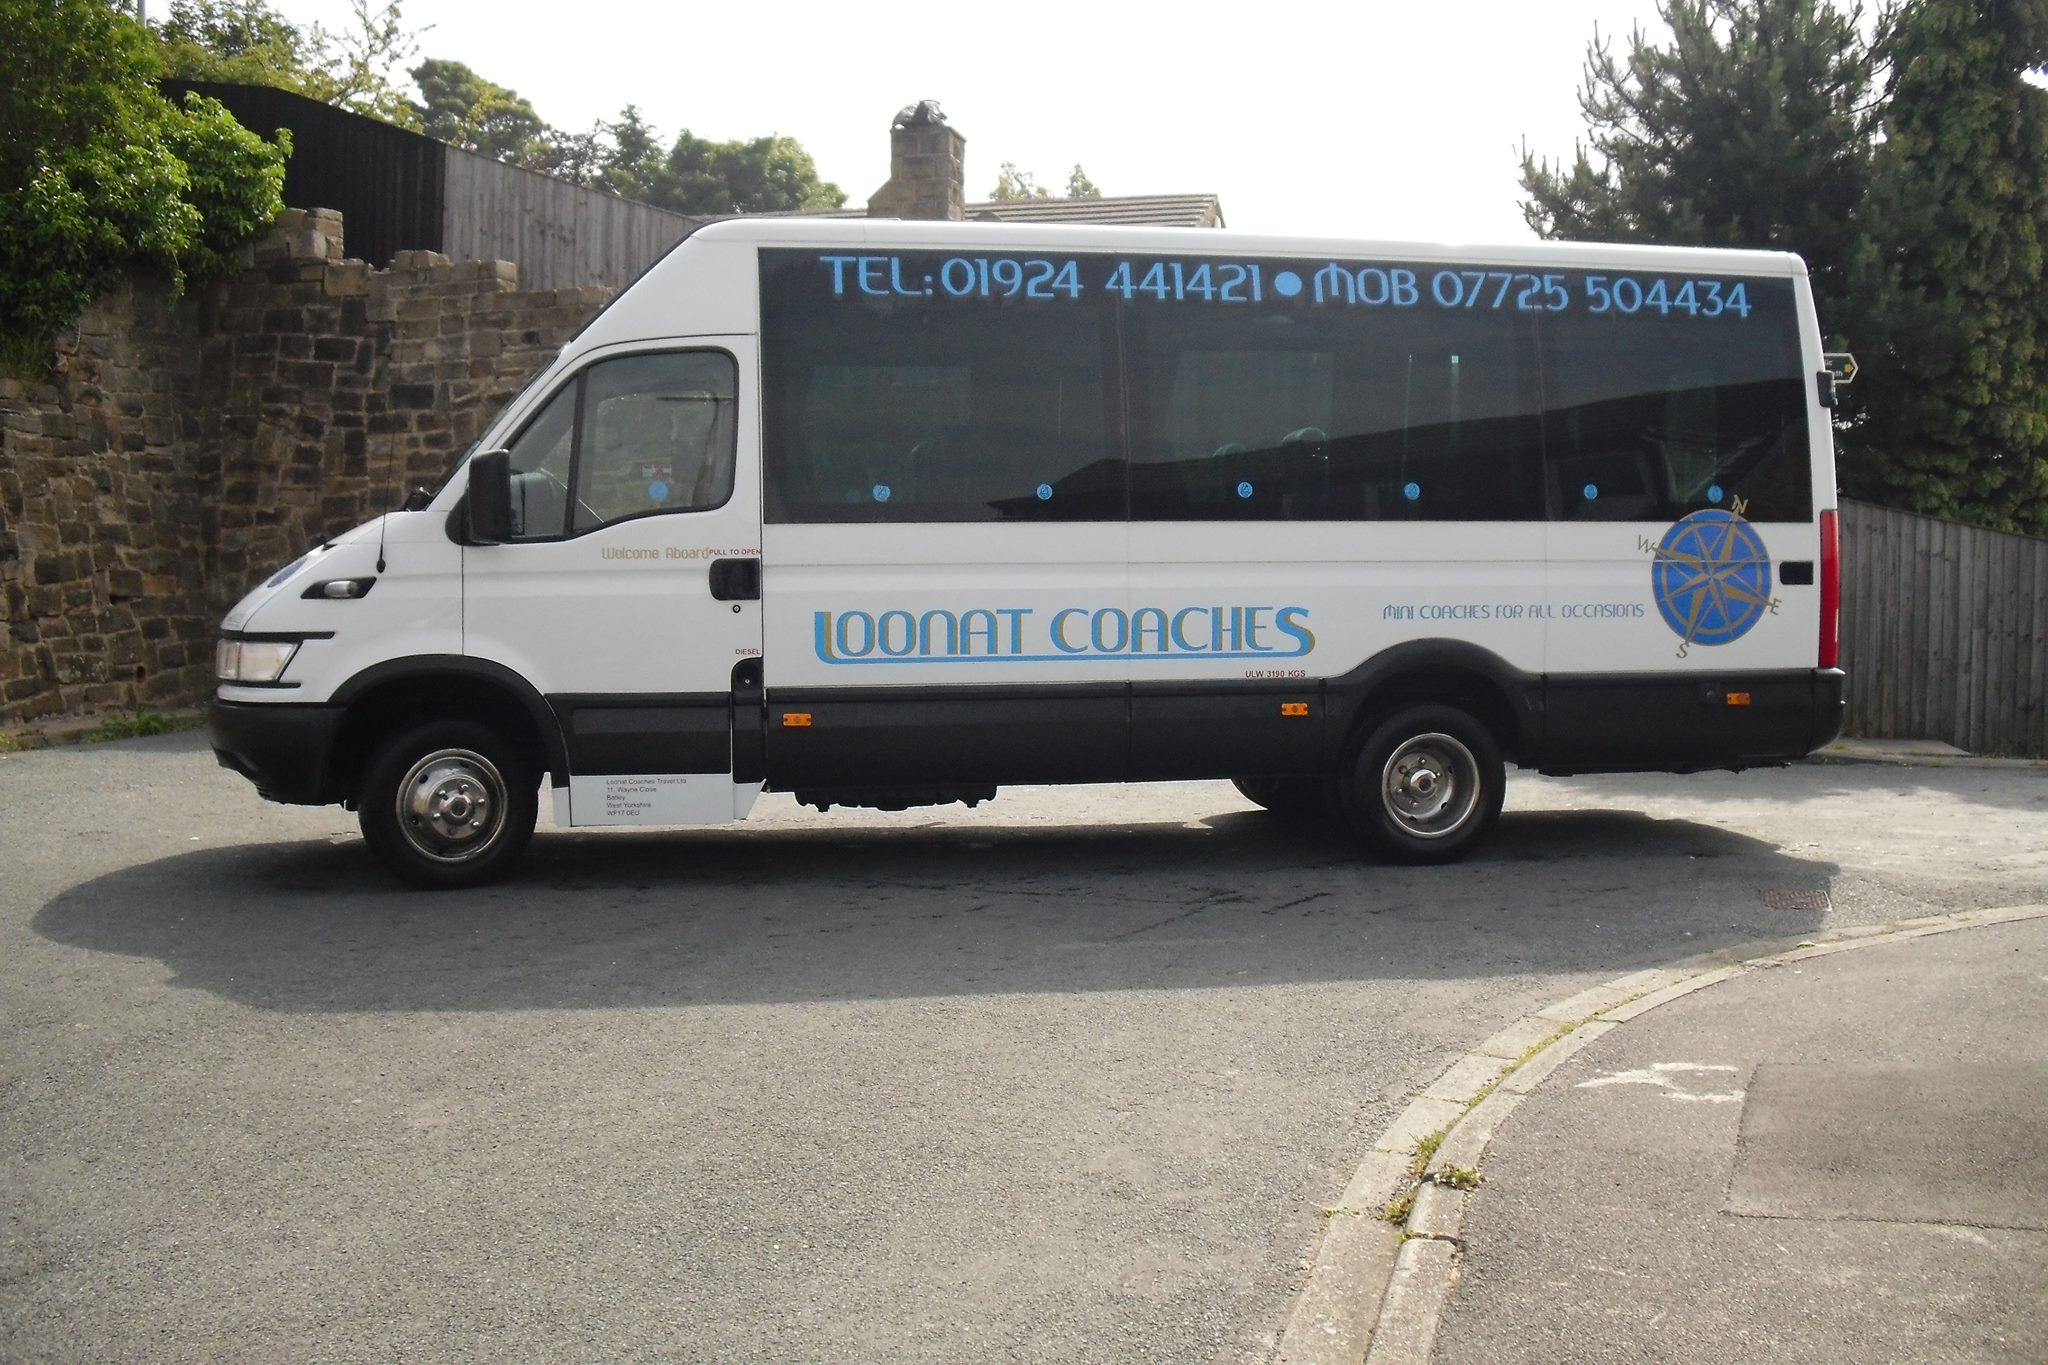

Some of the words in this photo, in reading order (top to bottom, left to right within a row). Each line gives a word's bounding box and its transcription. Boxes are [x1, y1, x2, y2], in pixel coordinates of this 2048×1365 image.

[1105, 261, 1262, 301] 441421
[1314, 262, 1418, 305] MOB
[1432, 271, 1568, 310] 07725
[1586, 276, 1751, 318] 504434
[602, 547, 659, 560] Welcome
[665, 547, 710, 560] Aboard
[730, 548, 740, 556] TO
[1383, 604, 1414, 620] MINI
[1419, 604, 1490, 619] COACHES
[1495, 603, 1524, 619] FOR
[1528, 603, 1557, 619] ALL
[1561, 603, 1645, 618] OCCASIONS
[814, 608, 1033, 664] LOONAT
[1050, 606, 1316, 657] COACHES
[735, 648, 760, 656] DIESEL
[1245, 670, 1264, 678] ULW
[1267, 670, 1285, 678] 3190
[1288, 669, 1306, 677] KGS
